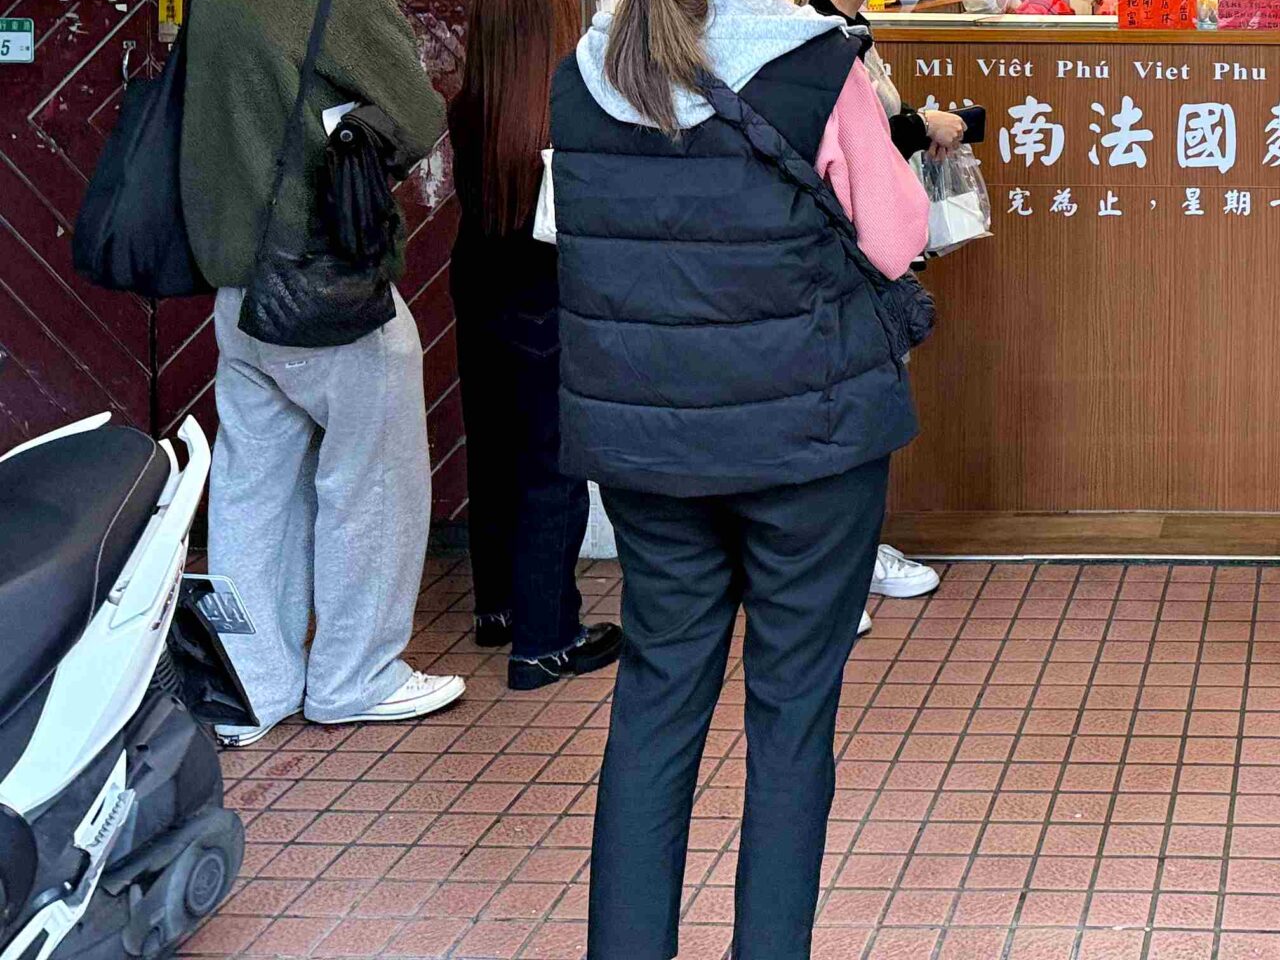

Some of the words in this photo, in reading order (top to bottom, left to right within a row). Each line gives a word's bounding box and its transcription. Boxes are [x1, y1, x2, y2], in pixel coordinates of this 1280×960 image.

[0, 40, 11, 56] 5
[915, 58, 954, 77] Mì
[977, 58, 1034, 78] Viêt
[1056, 59, 1110, 79] Phú
[1133, 60, 1190, 80] Viet
[1213, 62, 1267, 81] Phu
